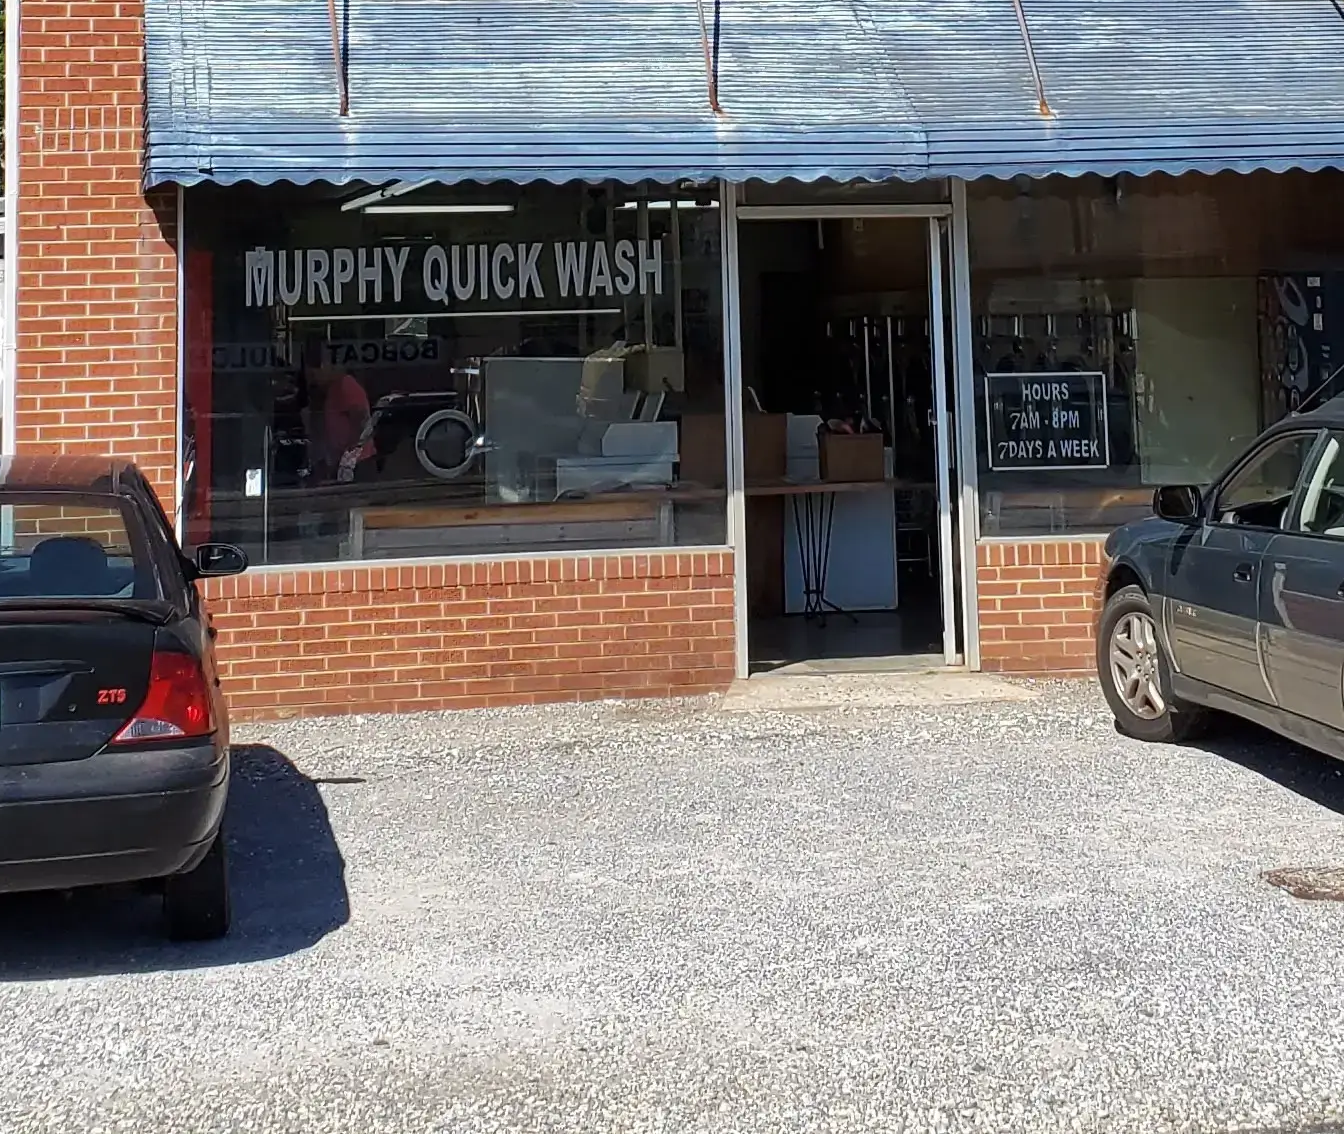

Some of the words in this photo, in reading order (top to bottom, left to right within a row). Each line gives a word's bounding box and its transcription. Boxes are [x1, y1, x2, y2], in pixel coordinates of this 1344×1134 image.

[245, 246, 410, 307] MURPHY
[423, 243, 544, 305] QUICK
[555, 240, 663, 297] WASH
[1021, 382, 1069, 401] HOURS
[1009, 411, 1040, 430] 7AM
[1052, 410, 1080, 428] 8PM
[1047, 440, 1057, 458] A
[1060, 439, 1099, 458] WEEK
